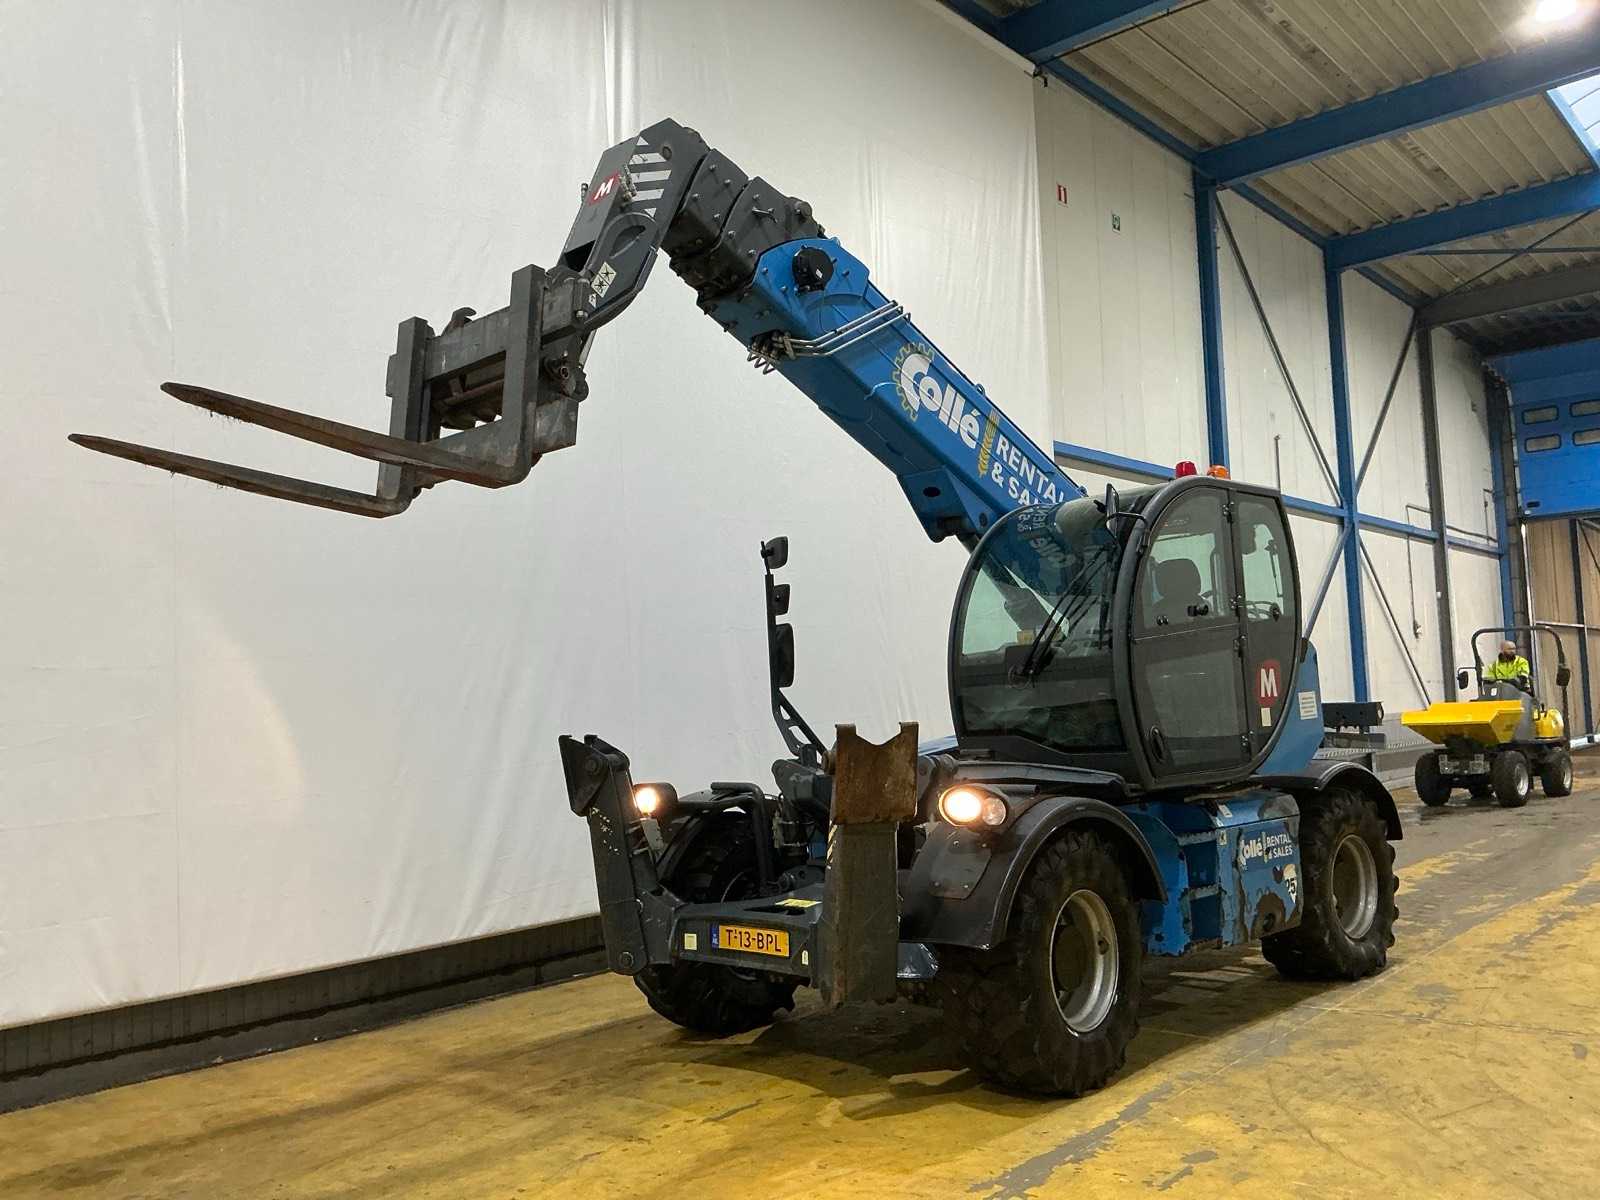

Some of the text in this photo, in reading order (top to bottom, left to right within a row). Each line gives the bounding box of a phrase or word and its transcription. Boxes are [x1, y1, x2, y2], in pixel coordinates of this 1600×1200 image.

[593, 177, 615, 201] M
[900, 353, 980, 449] Collé
[991, 462, 1004, 489] &
[1260, 668, 1278, 698] M
[1266, 833, 1292, 848] RENTAL
[1273, 844, 1293, 859] SALES
